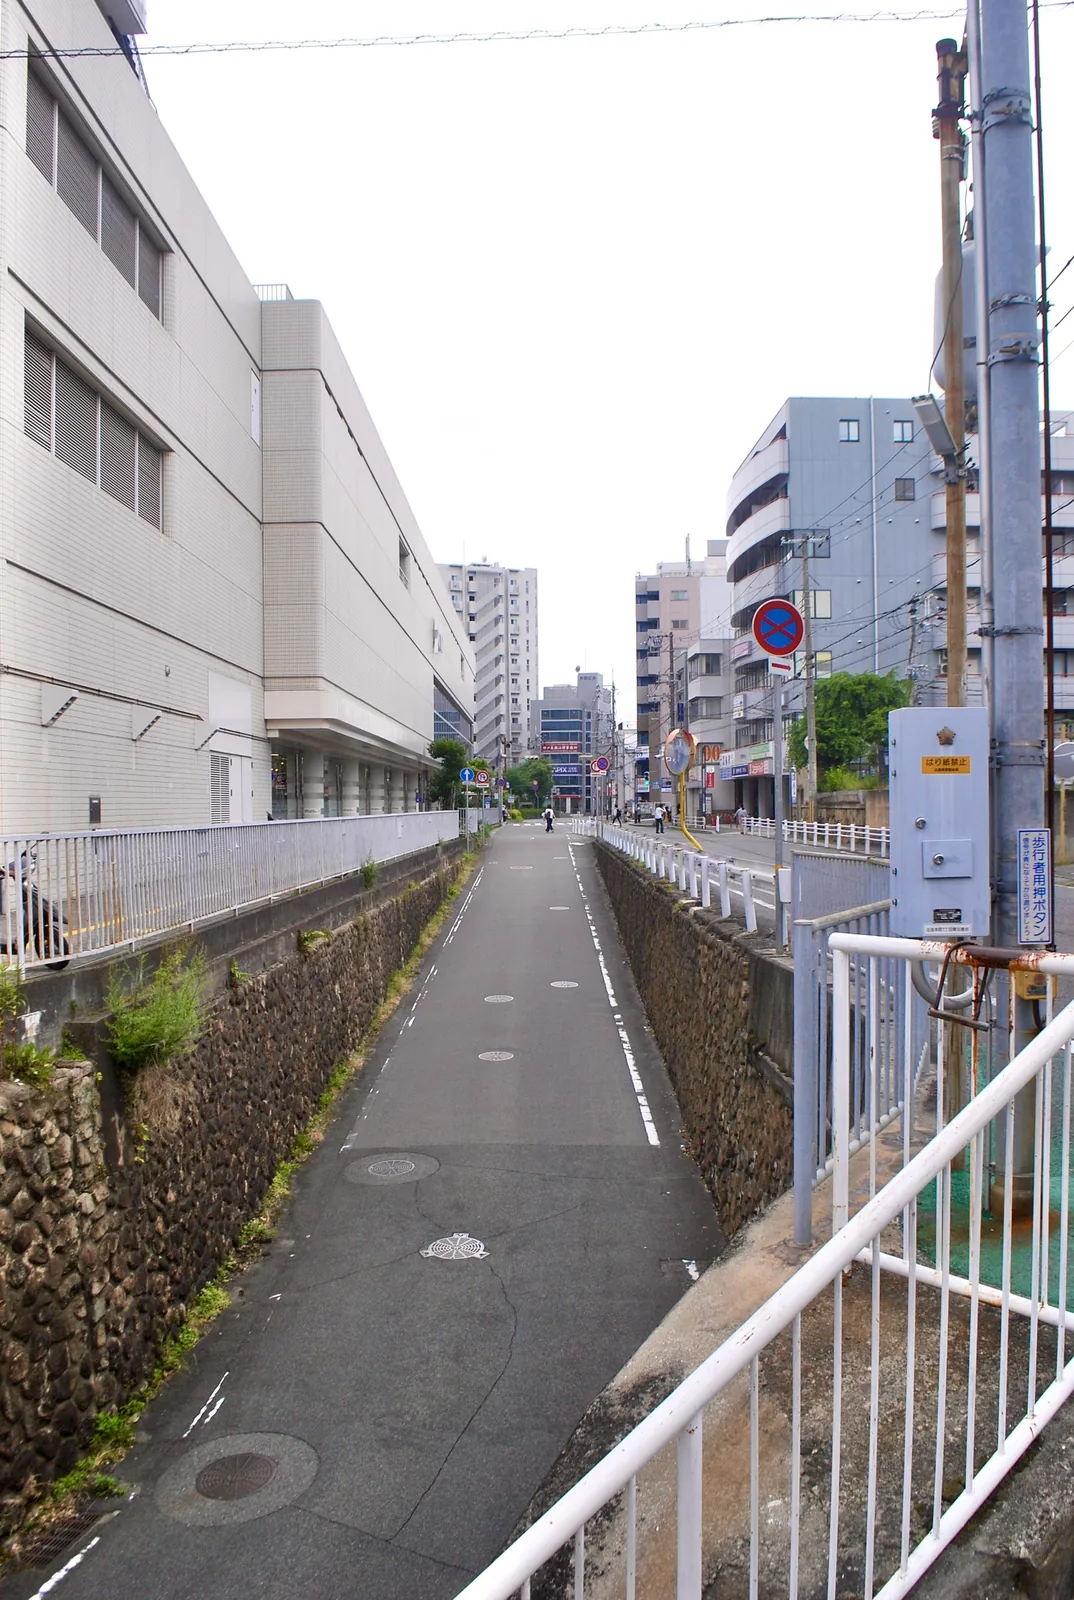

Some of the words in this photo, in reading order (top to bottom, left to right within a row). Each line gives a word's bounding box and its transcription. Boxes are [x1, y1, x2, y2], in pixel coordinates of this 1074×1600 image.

[925, 758, 967, 766] はり紙禁止
[1032, 836, 1047, 937] 歩行者用押ボタン
